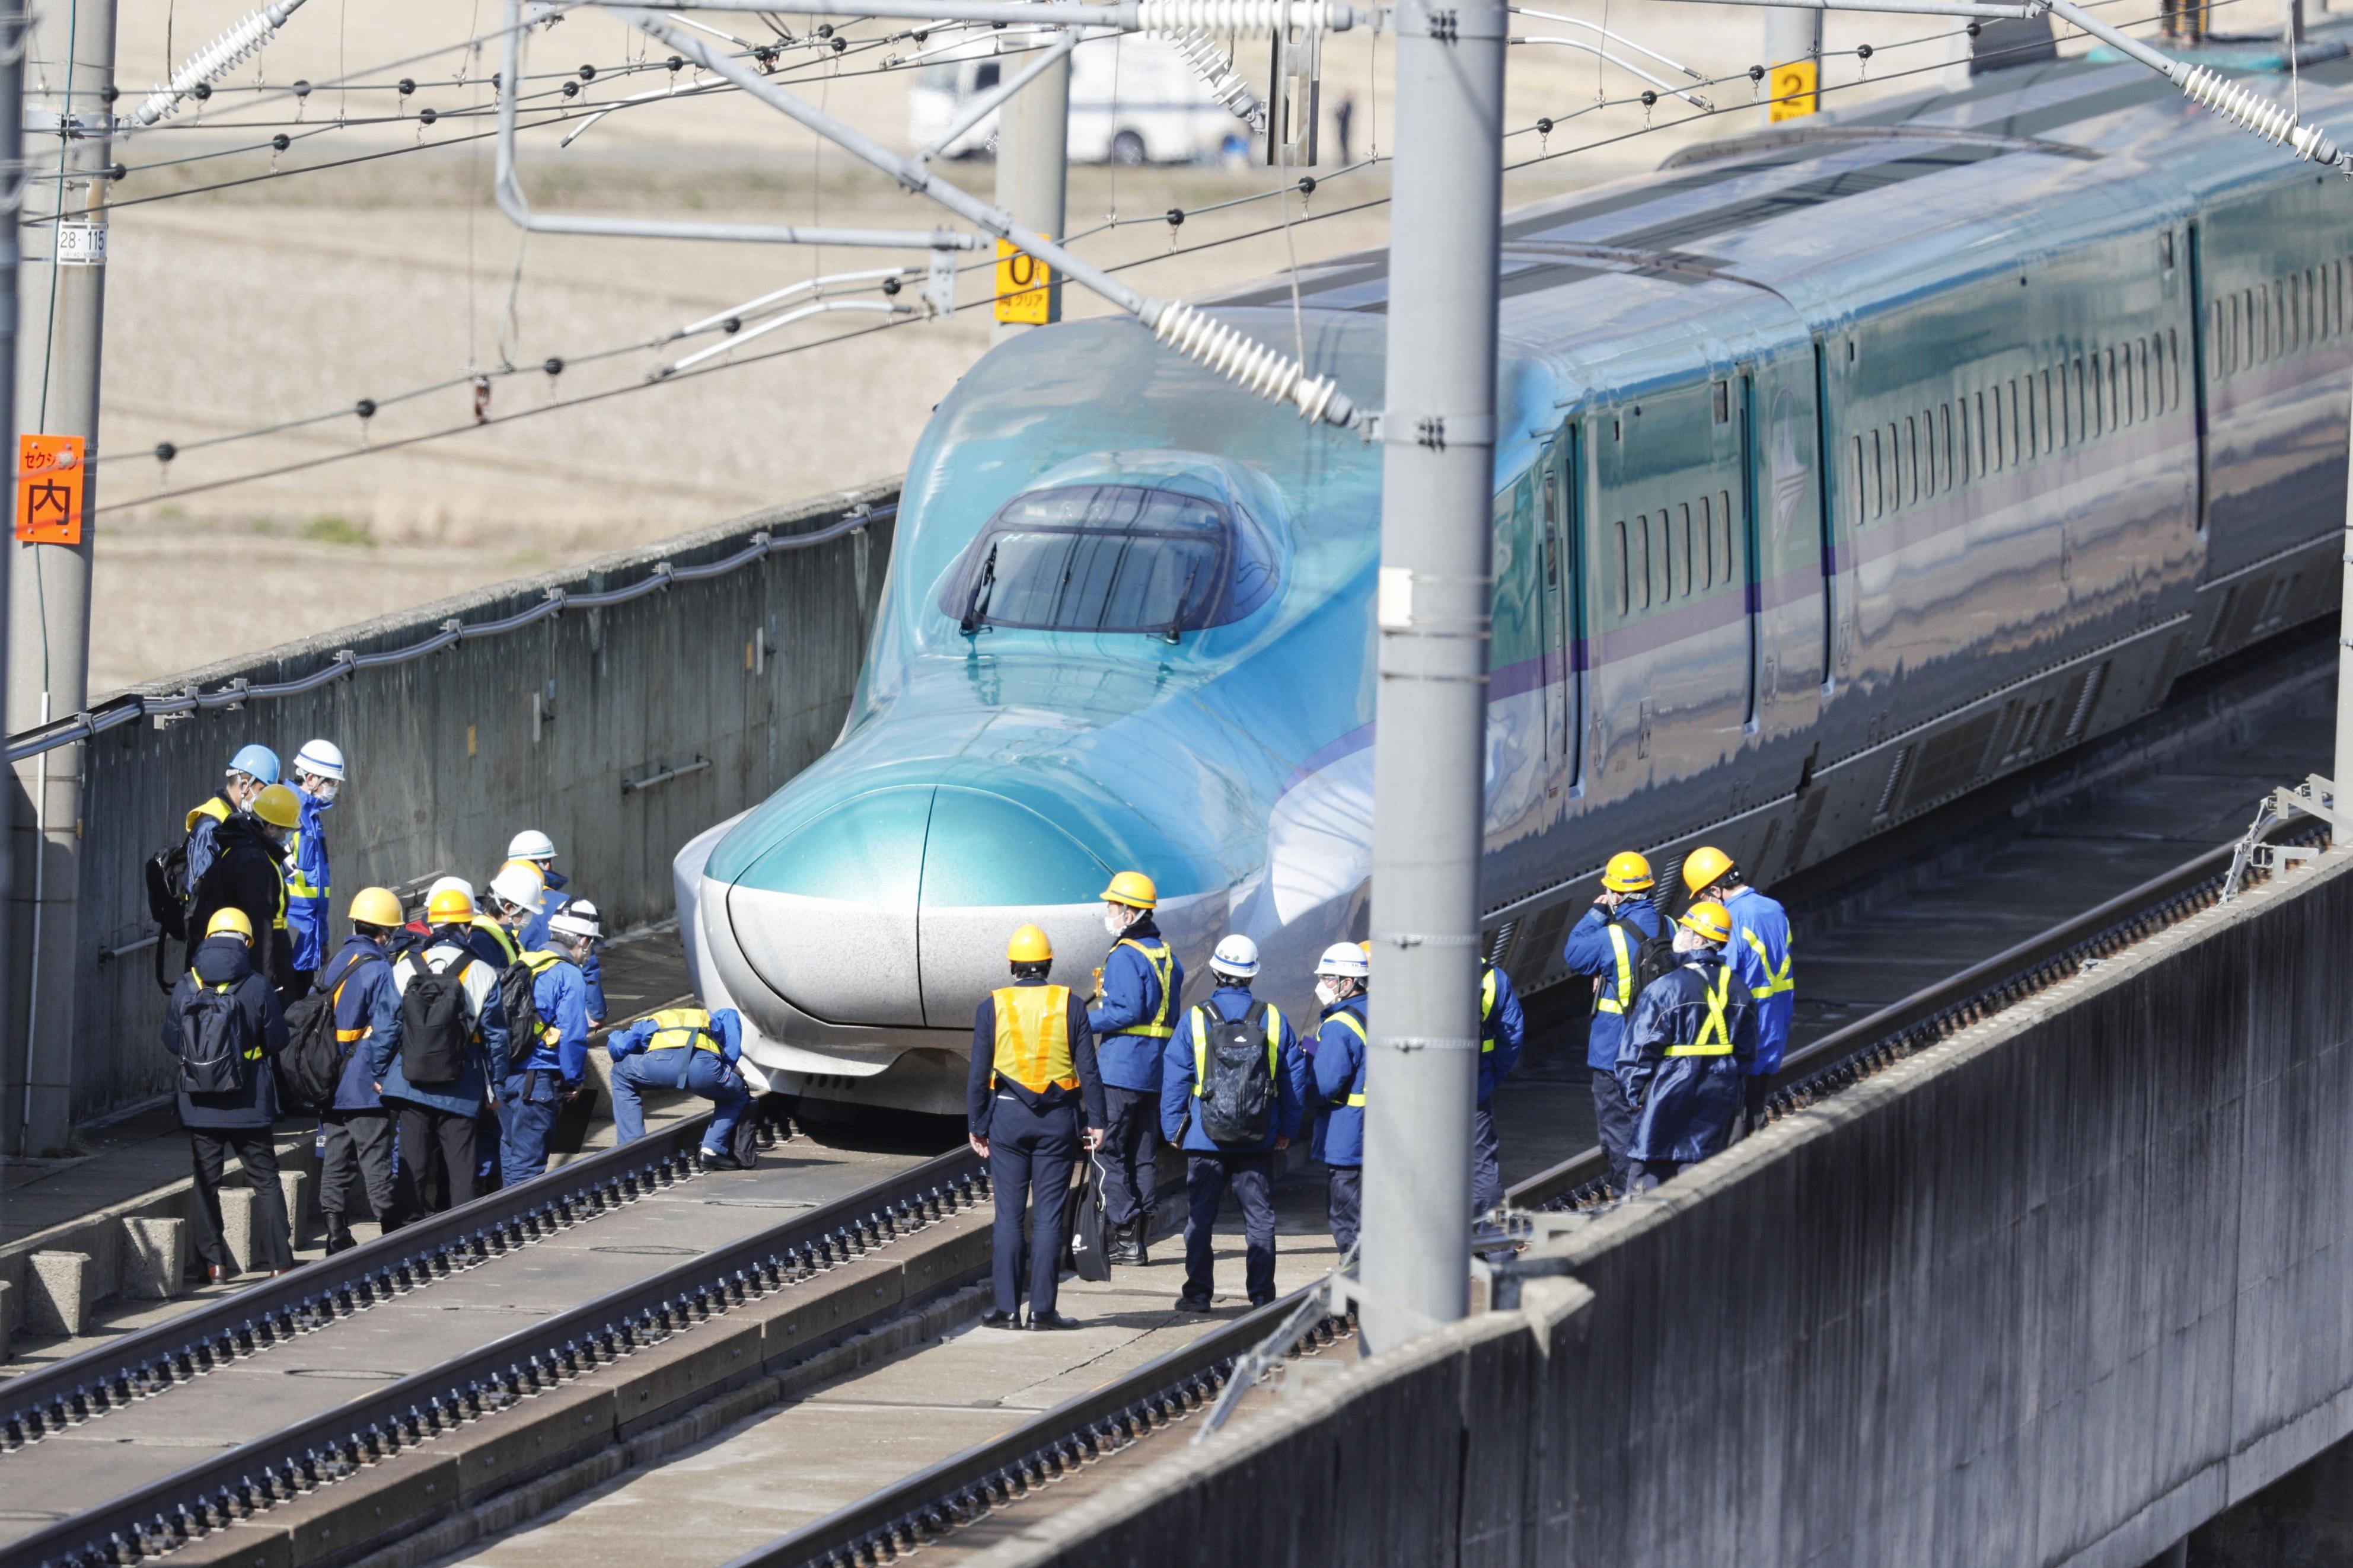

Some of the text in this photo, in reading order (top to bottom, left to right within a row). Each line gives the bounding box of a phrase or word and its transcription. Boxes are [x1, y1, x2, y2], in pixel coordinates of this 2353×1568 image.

[1783, 74, 1802, 106] 2
[1010, 250, 1034, 285] 0
[28, 478, 71, 525] 内
